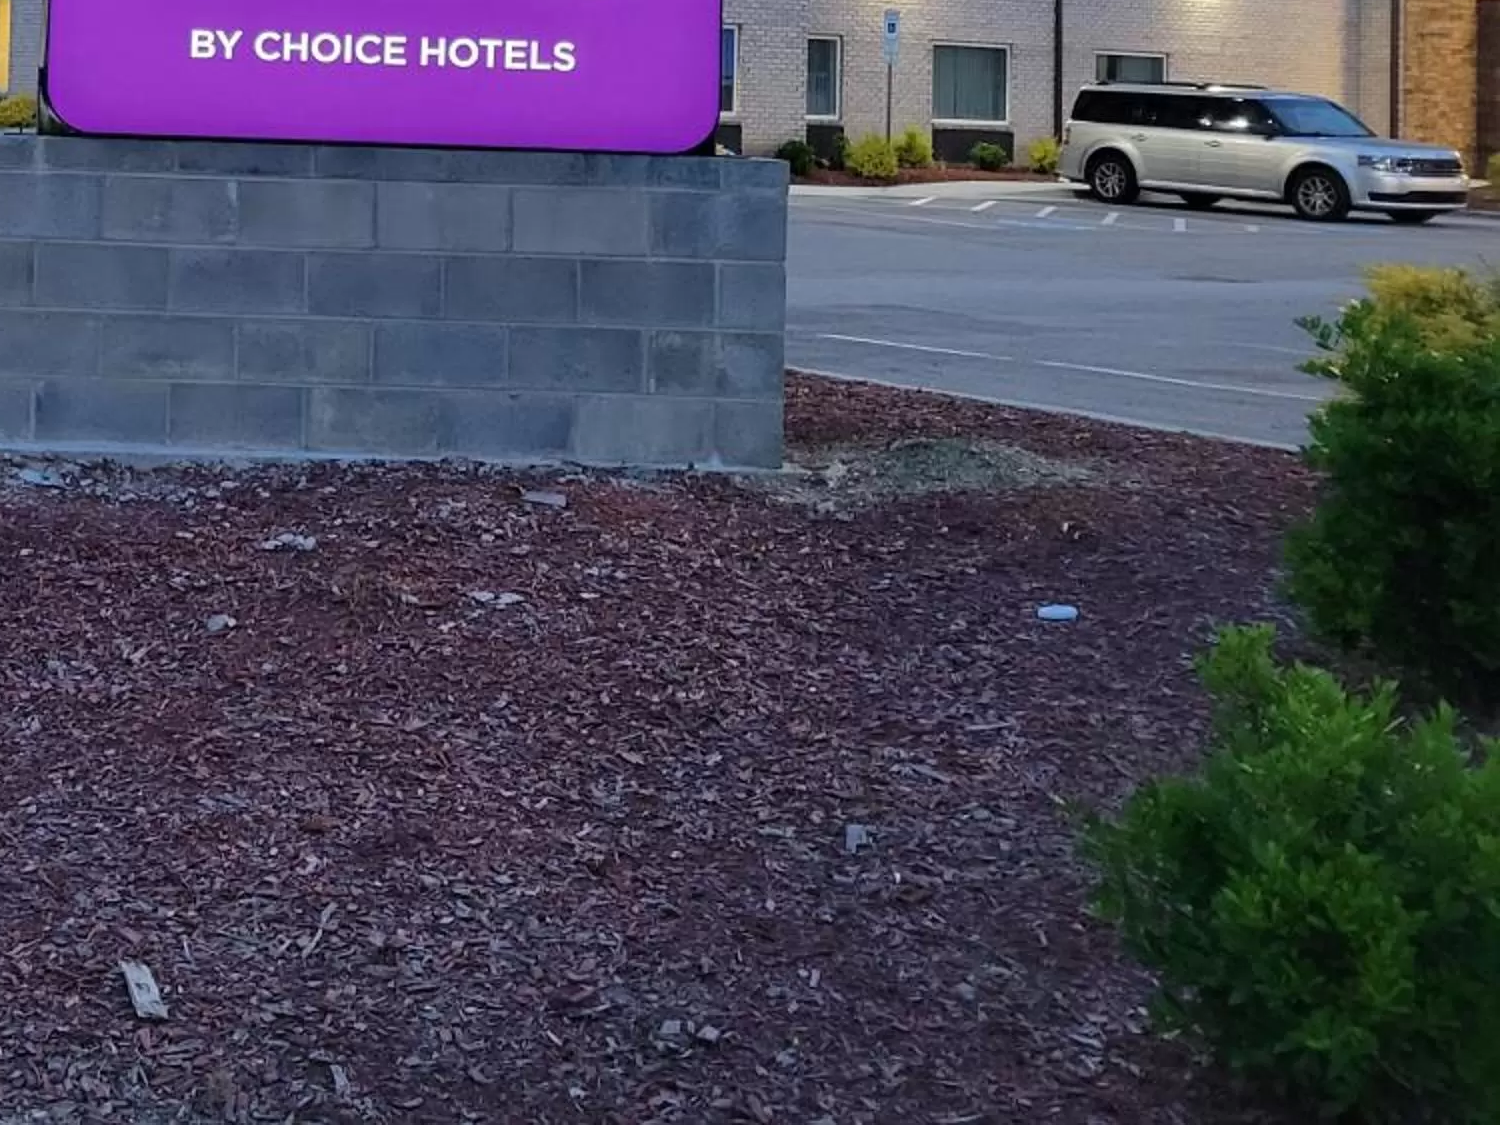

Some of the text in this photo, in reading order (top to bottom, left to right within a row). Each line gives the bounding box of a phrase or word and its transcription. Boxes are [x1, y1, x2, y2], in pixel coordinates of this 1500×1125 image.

[190, 29, 577, 71] BY CHOICE HOTELS
